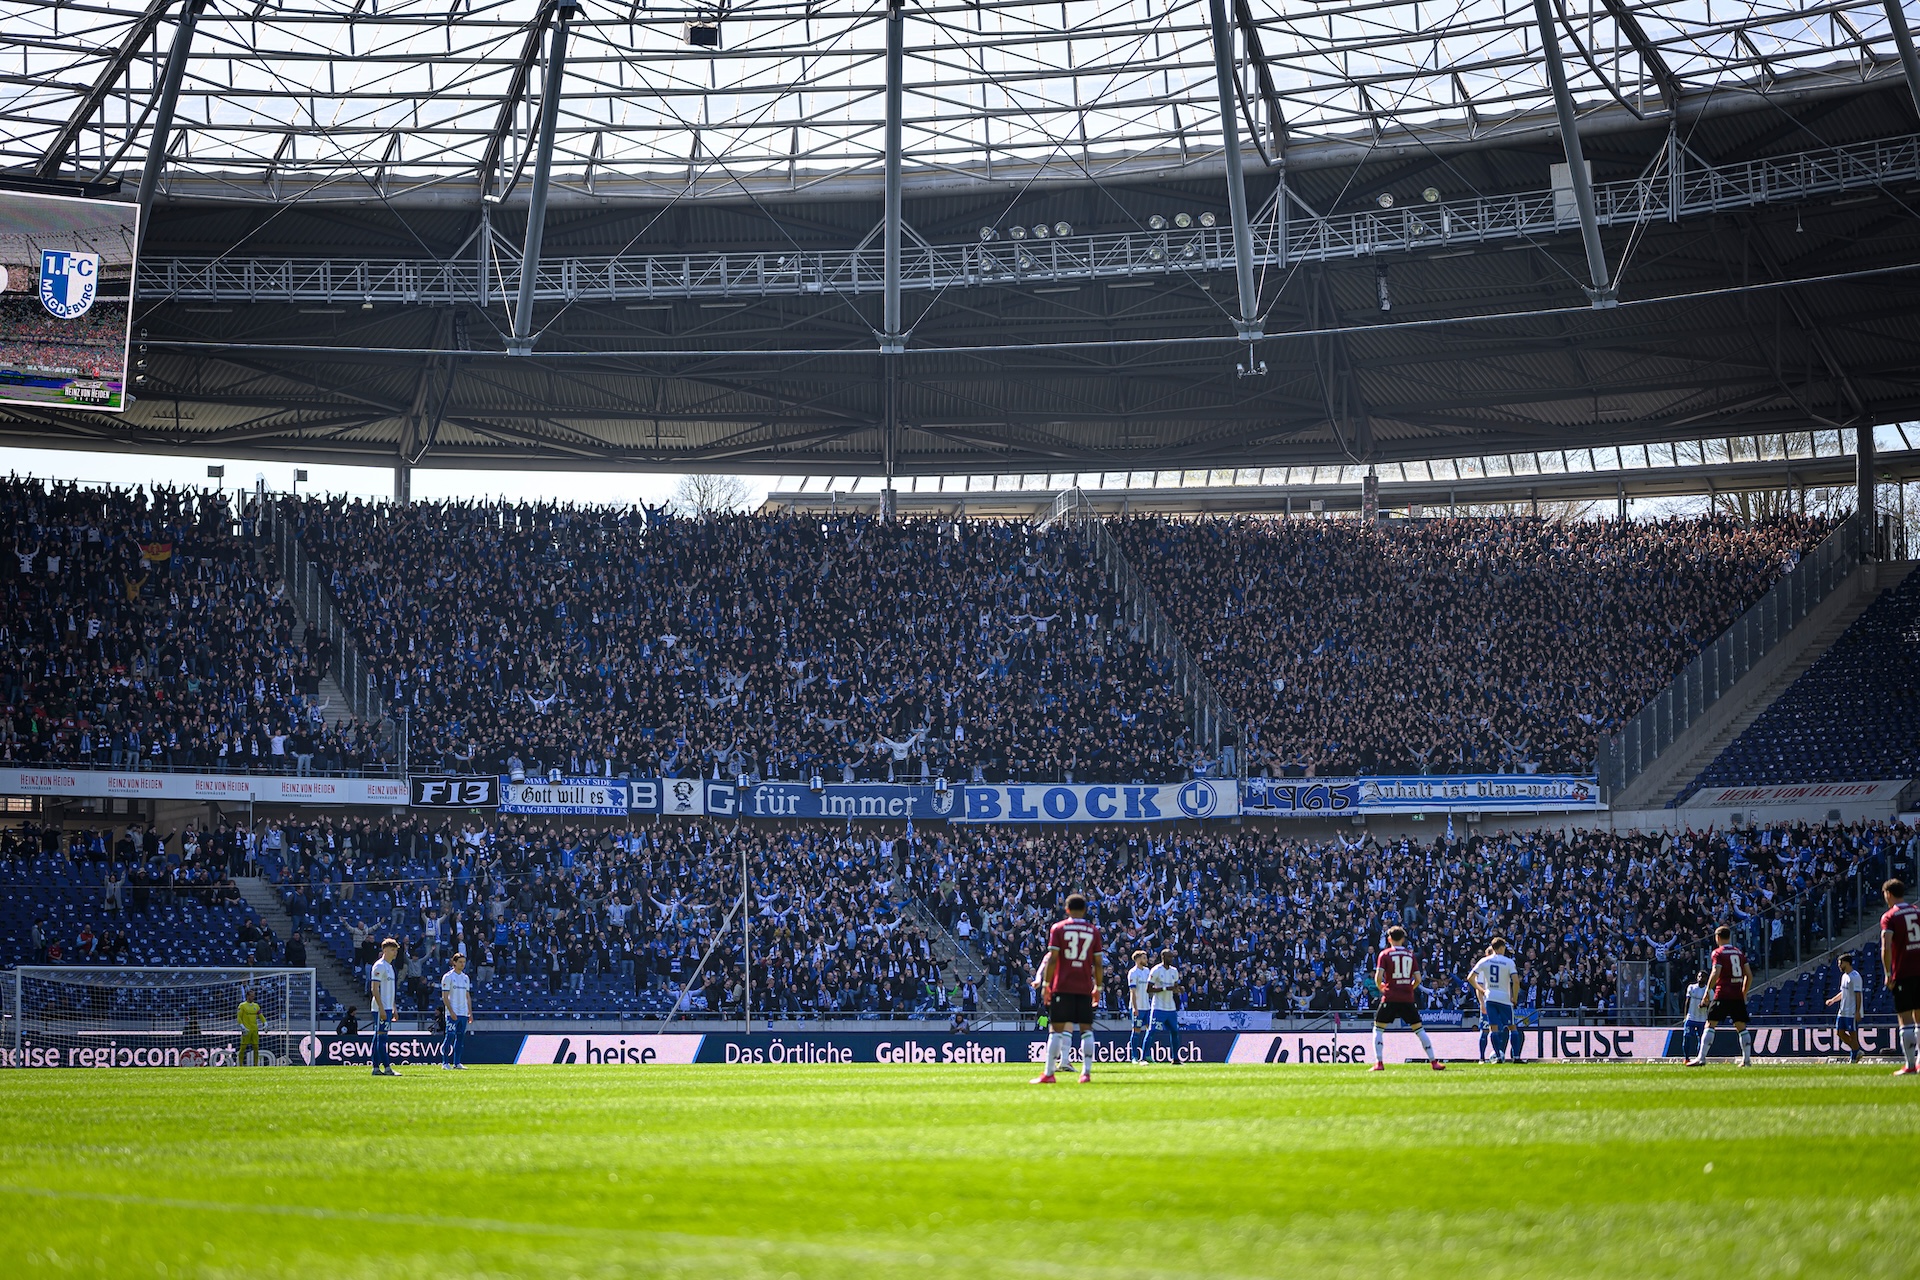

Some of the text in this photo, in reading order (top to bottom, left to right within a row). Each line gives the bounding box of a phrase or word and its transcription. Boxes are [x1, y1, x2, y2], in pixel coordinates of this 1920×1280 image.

[42, 278, 93, 315] MAGDEBURG
[20, 774, 75, 787] HEINZ VON HEIDEN
[108, 777, 163, 789] HEINZ VON HEIDEN
[195, 780, 249, 791] HEINZ VON HEIDEN
[281, 782, 335, 794] HEINZ VON HEIDEN
[367, 784, 384, 795] HEINZ
[386, 786, 397, 795] VON
[569, 778, 591, 786] EAST
[592, 779, 612, 787] SIDE
[521, 786, 552, 803] Gott
[557, 787, 584, 804] will
[590, 790, 604, 804] es
[630, 782, 735, 815] B G
[753, 785, 918, 816] für immer
[965, 787, 1161, 819] BLOCK
[1253, 783, 1351, 810] 1965
[1362, 780, 1569, 804] Anhalt ist blau-weiß
[1717, 784, 1880, 801] HEINZ VON HEIDEN
[517, 806, 572, 814] MAGDEBURG
[575, 805, 598, 814] ÜBER
[600, 807, 628, 815] ALLES
[1064, 931, 1093, 960] 37
[1391, 955, 1413, 979] 10
[1489, 964, 1500, 983] 9
[1730, 954, 1742, 977] 8
[448, 1023, 456, 1031] 24
[586, 1039, 656, 1064] heise
[725, 1038, 853, 1064] Das Örtliche
[875, 1041, 1006, 1063] Gelbe Seiten
[1298, 1037, 1366, 1063] heise
